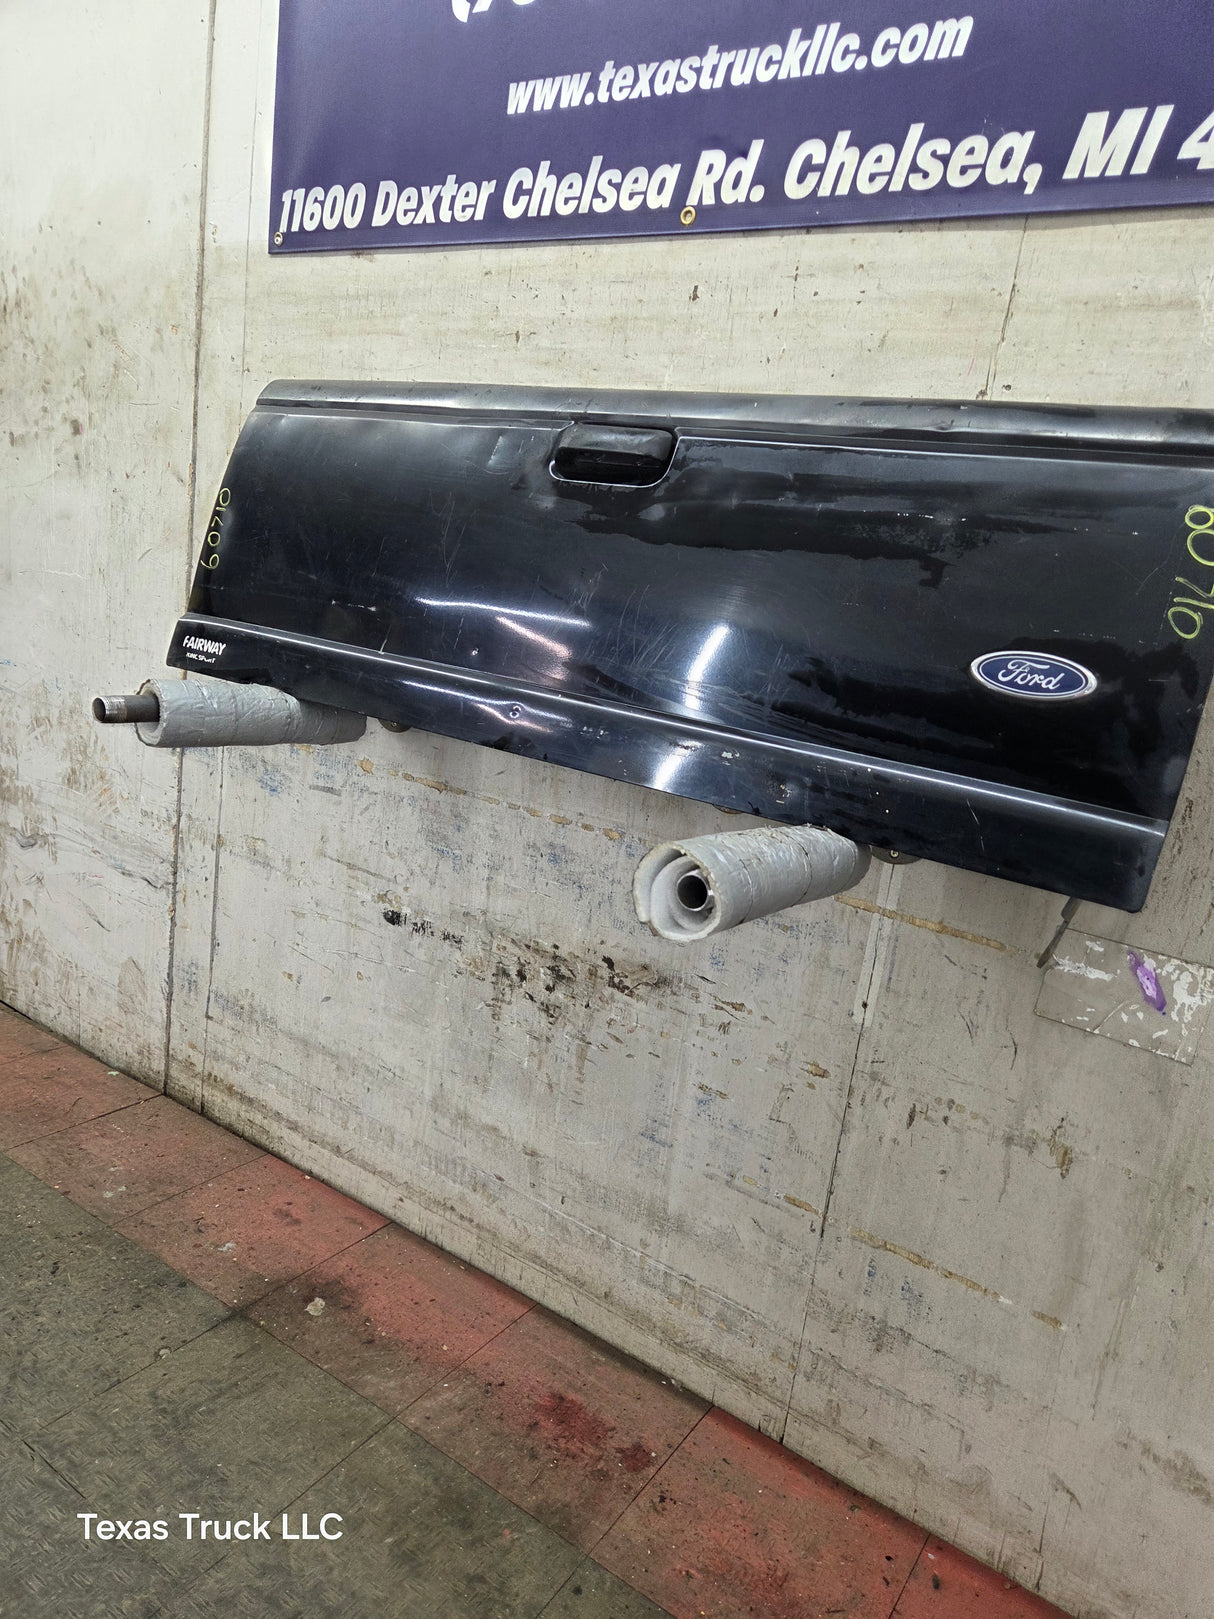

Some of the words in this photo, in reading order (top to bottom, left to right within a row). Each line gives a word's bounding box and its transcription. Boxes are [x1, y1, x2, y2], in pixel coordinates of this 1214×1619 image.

[507, 15, 973, 115] www.texastruckllc.com
[279, 182, 367, 234] 11600
[371, 174, 497, 227] Dexter
[503, 156, 681, 219] Chelsea
[686, 139, 765, 206] Rd.
[784, 123, 1043, 200] Chelsea,
[1062, 104, 1175, 180] MI
[182, 635, 227, 656] FAIRWAY
[998, 659, 1065, 690] Ford
